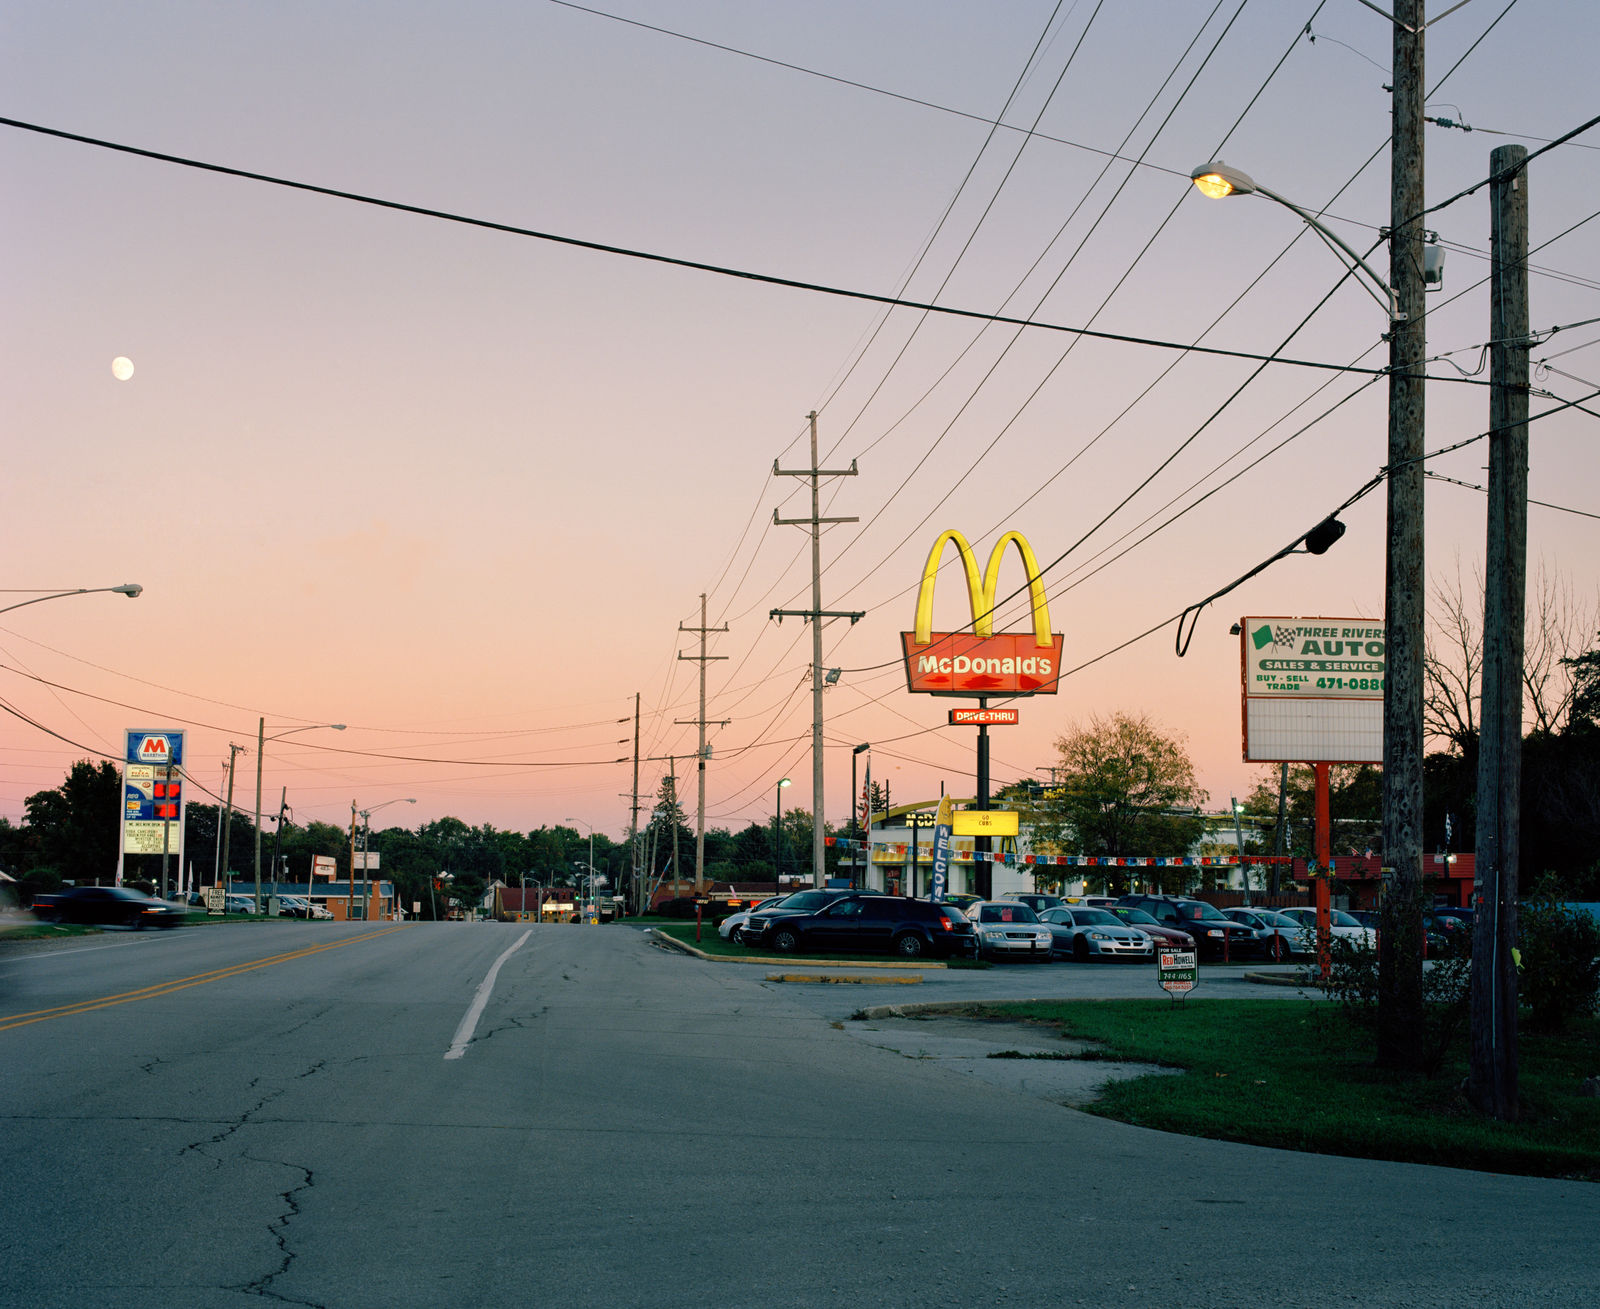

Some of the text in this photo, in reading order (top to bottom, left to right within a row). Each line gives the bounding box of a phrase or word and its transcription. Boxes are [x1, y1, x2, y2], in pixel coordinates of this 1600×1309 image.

[1295, 627, 1338, 638] THREE
[1300, 639, 1386, 657] AUTO
[917, 655, 1052, 675] McDonald's
[1265, 660, 1379, 671] SALES & SERVICE
[1256, 674, 1277, 682] BUY
[1286, 674, 1309, 682] SELL
[1266, 683, 1300, 691] TRADE
[956, 711, 1015, 721] DRIVE-THRU
[143, 738, 166, 753] M
[933, 825, 949, 902] WELCOM
